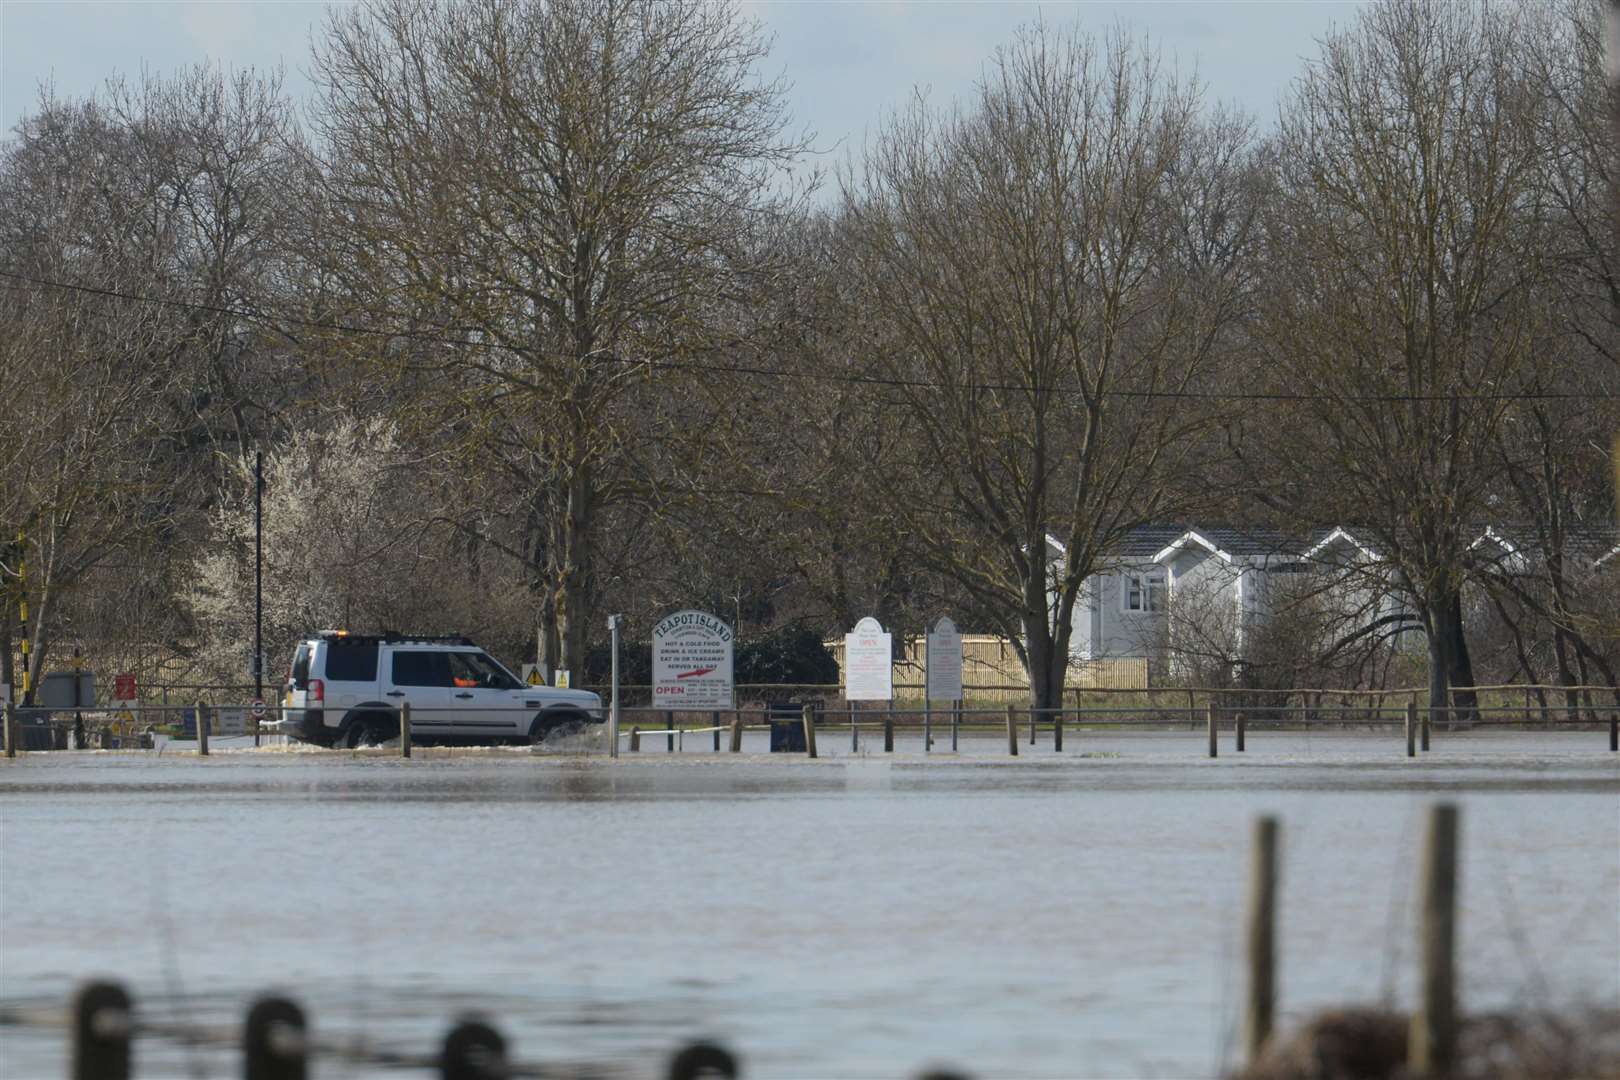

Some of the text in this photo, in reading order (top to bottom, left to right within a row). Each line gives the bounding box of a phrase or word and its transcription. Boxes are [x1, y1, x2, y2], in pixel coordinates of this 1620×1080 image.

[656, 613, 693, 638] TEAPOT
[695, 613, 731, 642] ISLAND
[655, 686, 685, 695] OPEN
